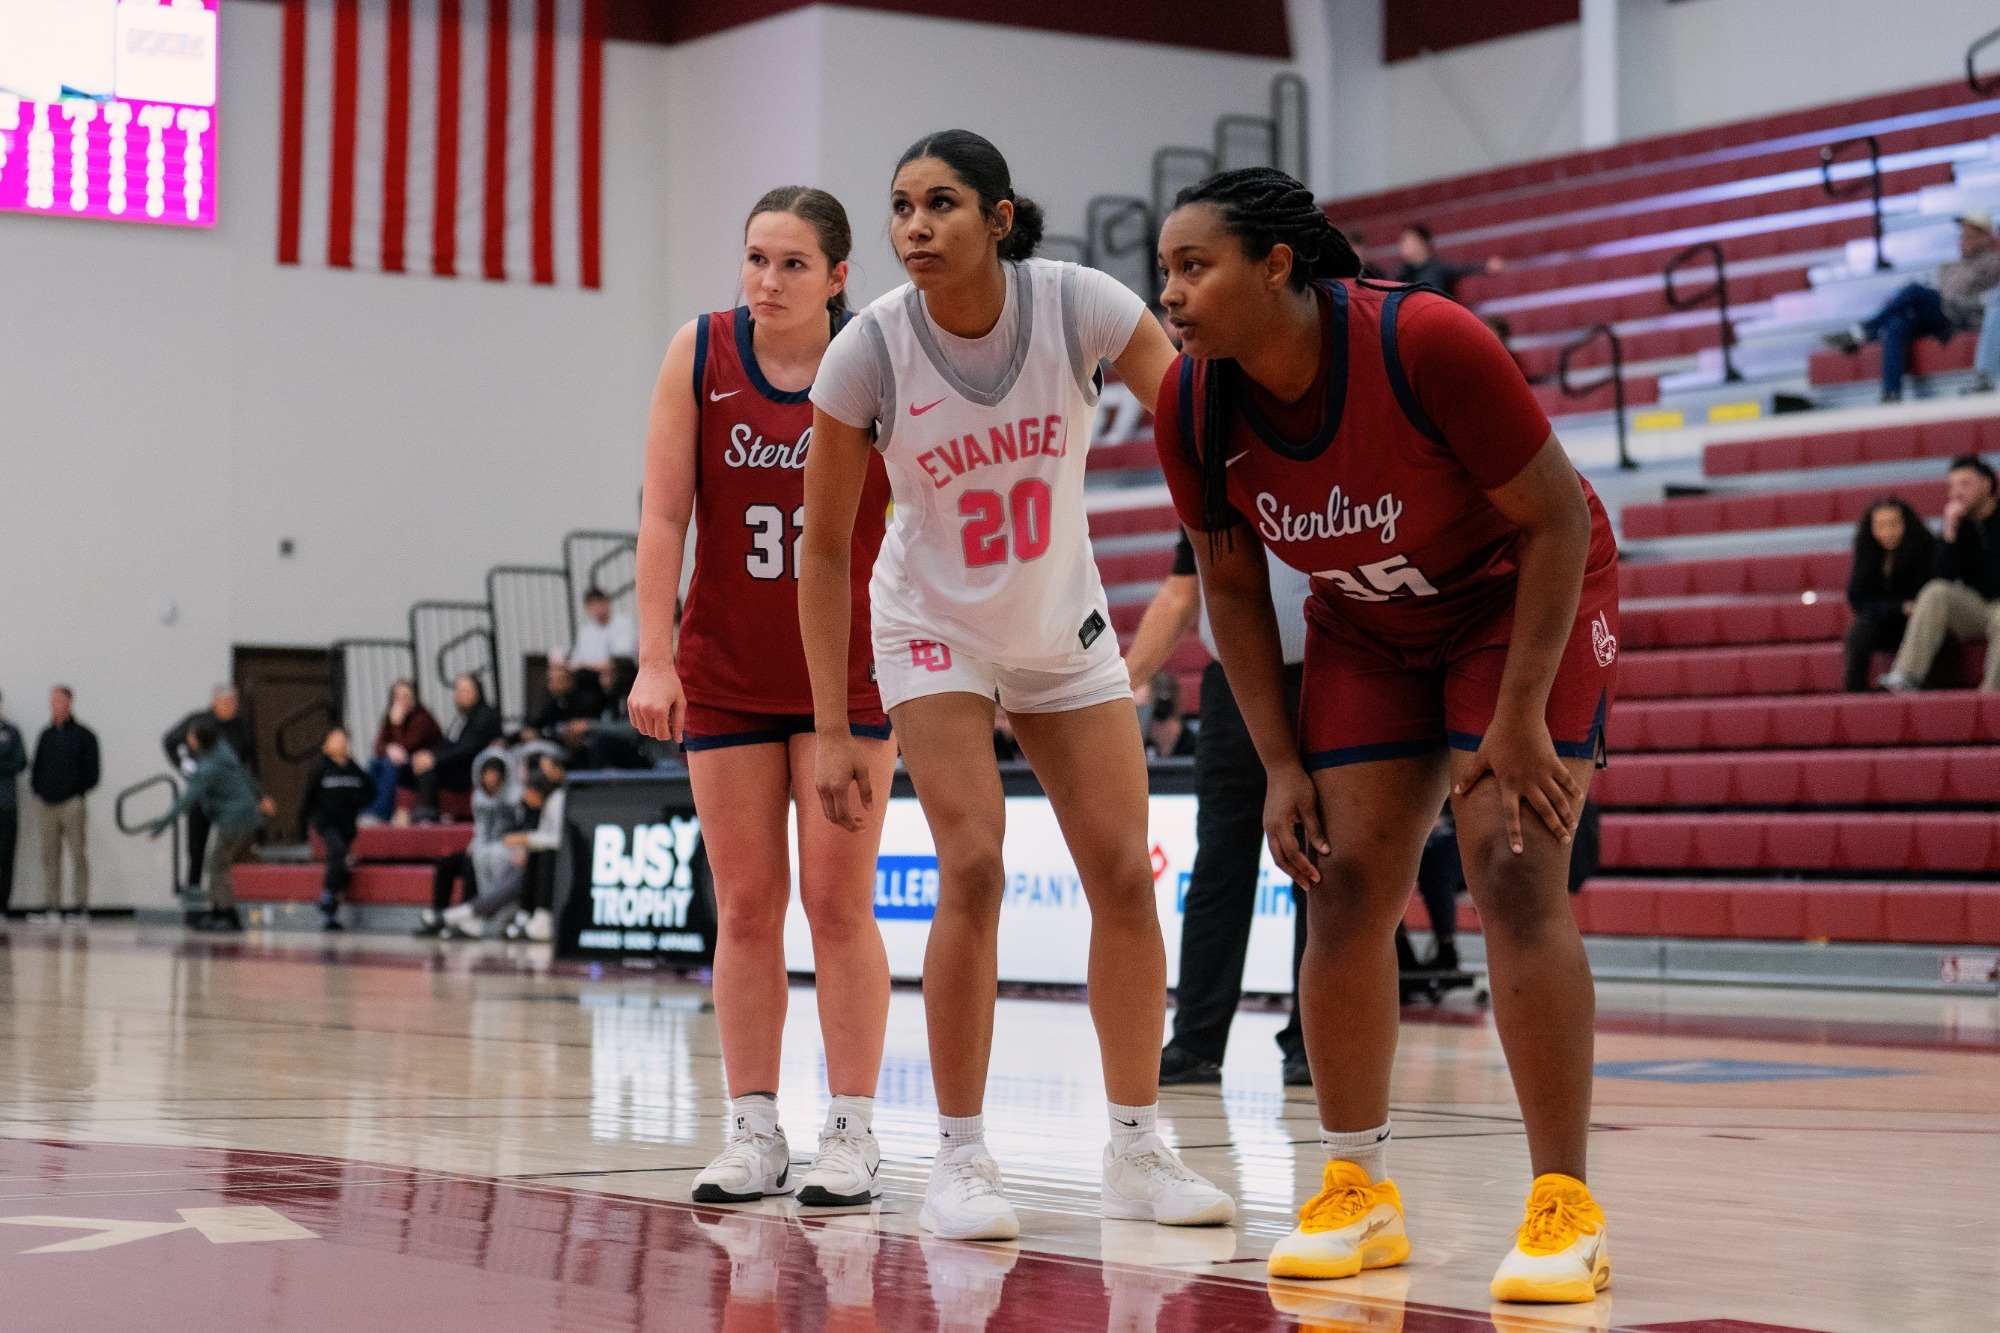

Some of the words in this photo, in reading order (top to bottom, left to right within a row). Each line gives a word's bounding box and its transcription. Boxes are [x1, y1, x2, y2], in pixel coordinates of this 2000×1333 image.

[724, 422, 813, 470] Sterl
[915, 413, 1068, 490] EVANGE
[957, 476, 1053, 569] 20
[1256, 484, 1403, 544] Sterling
[1311, 553, 1439, 602] 35
[590, 887, 694, 928] TROPHY
[874, 868, 939, 907] LLER
[1004, 872, 1080, 909] PANY
